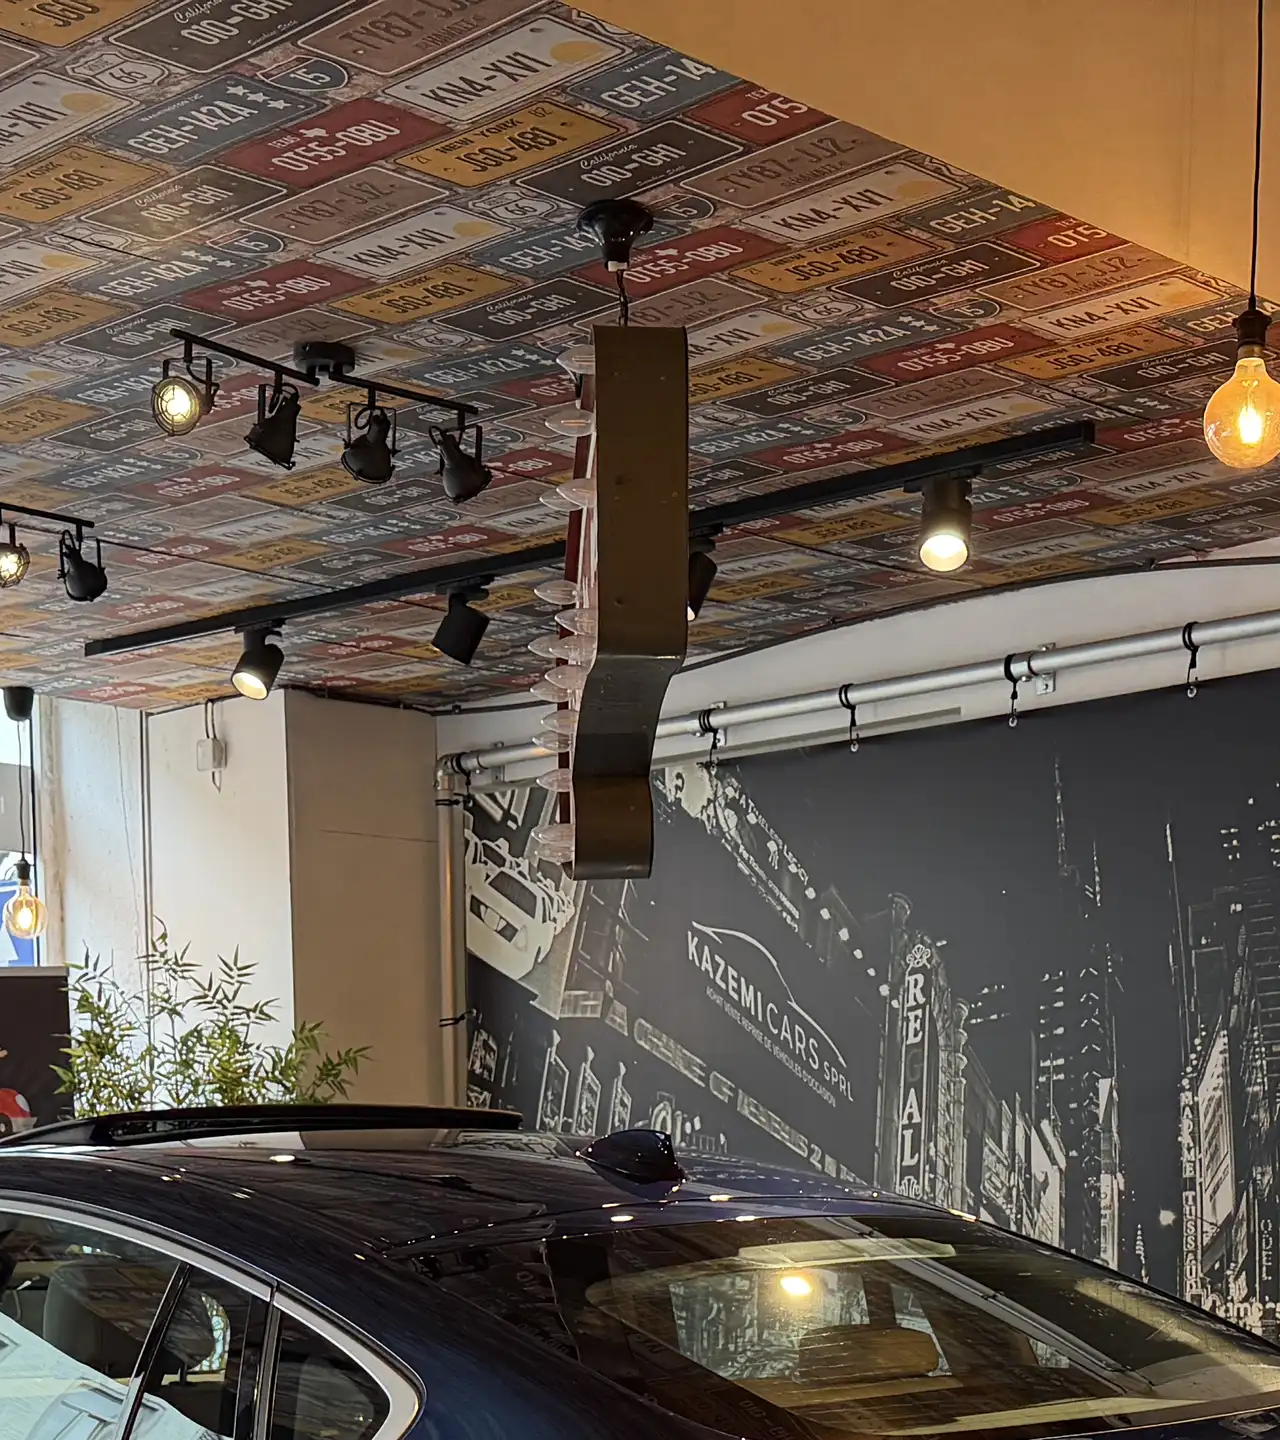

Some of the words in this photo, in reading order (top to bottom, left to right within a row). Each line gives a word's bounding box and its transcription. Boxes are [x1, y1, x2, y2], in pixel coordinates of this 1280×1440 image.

[108, 64, 146, 87] 66
[298, 66, 333, 87] 15
[125, 98, 260, 157] GEH-142A
[579, 142, 639, 171] California
[686, 929, 764, 1023] KAZEMI
[765, 1001, 820, 1071] CARS
[822, 1059, 855, 1103] SPRL
